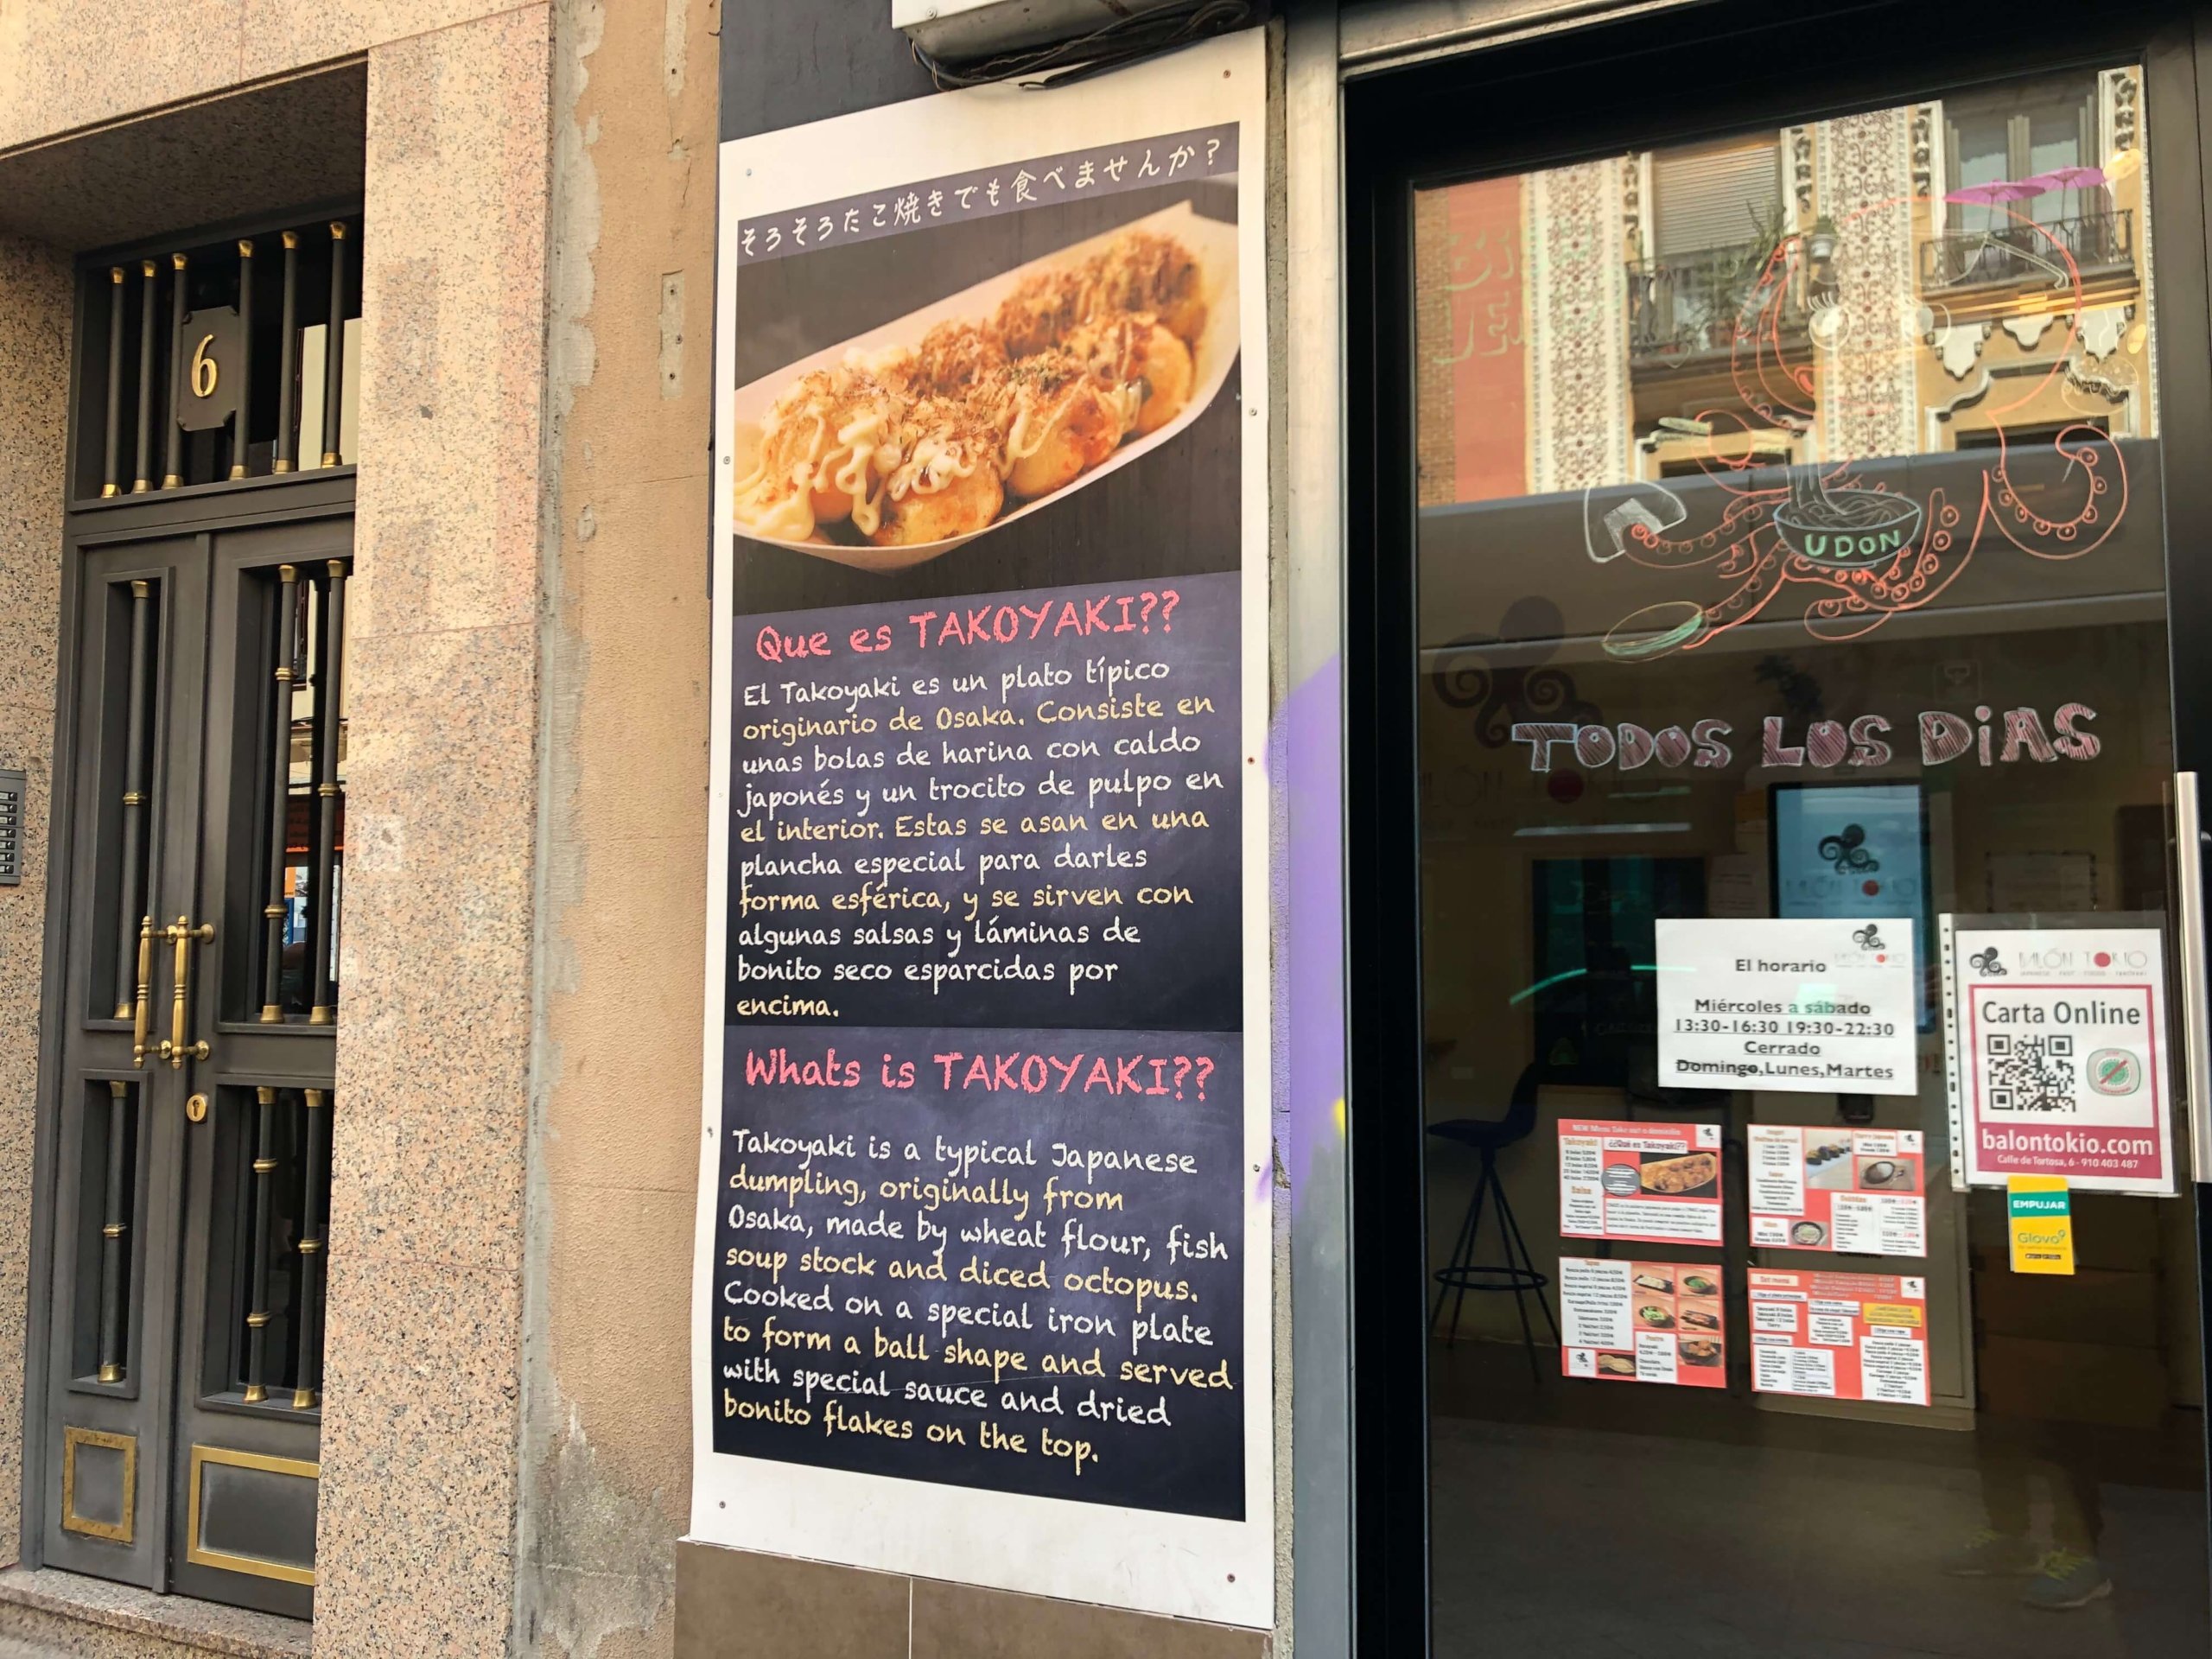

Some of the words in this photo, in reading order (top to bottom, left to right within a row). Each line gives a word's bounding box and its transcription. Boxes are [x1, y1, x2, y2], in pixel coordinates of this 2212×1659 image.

[191, 334, 217, 398] 6
[1804, 529, 1902, 558] UDON
[755, 625, 832, 664] Que
[849, 624, 892, 653] es
[908, 589, 1180, 649] TAKOYAKI??
[743, 682, 771, 707] El
[779, 676, 901, 714] Takoyaki
[912, 677, 940, 696] es
[952, 673, 988, 693] un
[1001, 662, 1073, 704] plato
[1086, 655, 1170, 698] típico
[742, 713, 878, 747] originario
[888, 706, 924, 731] de
[936, 705, 1025, 731] Osaka.
[1036, 692, 1164, 724] Consiste
[1177, 696, 1216, 715] en
[1511, 719, 1733, 772] TODOS
[1762, 714, 1892, 768] LOS
[742, 755, 803, 775] unas
[814, 744, 885, 772] bolas
[896, 741, 931, 766] de
[942, 741, 1033, 765] harina
[1046, 739, 1101, 760] con
[1114, 726, 1201, 756] caldo
[737, 779, 844, 820] japonés
[855, 789, 871, 817] y
[881, 785, 918, 804] un
[929, 773, 1026, 802] trocito
[1038, 769, 1075, 796] de
[1089, 767, 1173, 810] pulpo
[1185, 771, 1224, 791] en
[740, 818, 766, 843] el
[777, 817, 884, 842] interior.
[894, 812, 967, 837] Estas
[979, 817, 1008, 836] se
[1020, 813, 1089, 833] asan
[1101, 811, 1139, 831] en
[1151, 810, 1210, 830] una
[740, 850, 842, 891] plancha
[854, 847, 966, 893] especial
[979, 853, 1041, 886] para
[1053, 842, 1147, 869] darles
[739, 886, 821, 918] forma
[831, 880, 950, 917] esférica,
[963, 892, 978, 922] y
[991, 889, 1020, 907] se
[1032, 884, 1124, 907] sirven
[1136, 885, 1194, 905] con
[738, 922, 842, 955] algunas
[852, 920, 934, 945] salsas
[946, 928, 962, 959] y
[974, 914, 1090, 944] láminas
[1103, 915, 1141, 944] de
[738, 953, 823, 982] bonito
[832, 963, 893, 982] seco
[904, 953, 1055, 995] esparcidas
[1070, 963, 1119, 996] por
[1735, 959, 1751, 972] El
[1758, 959, 1827, 973] horario
[736, 994, 839, 1018] encima.
[1675, 1019, 1778, 1033] 13:30-16:30
[1786, 1020, 1895, 1036] 19:30-22:30
[1694, 999, 1782, 1014] Miércoles
[1788, 1003, 1798, 1014] a
[1804, 1000, 1872, 1014] sábado
[1982, 1001, 2044, 1024] Carta
[2053, 1000, 2140, 1025] Online
[1744, 1040, 1821, 1055] Cerrado
[745, 1047, 861, 1088] Whats
[881, 1053, 916, 1090] is
[933, 1051, 1215, 1103] TAKOYAKI??
[732, 1128, 856, 1171] Takoyaki
[868, 1135, 891, 1160] is
[904, 1142, 921, 1161] a
[935, 1135, 1038, 1179] typical
[1052, 1142, 1198, 1185] Japanese
[1982, 1128, 2153, 1155] balontokio.com
[1997, 1154, 2018, 1165] Calle
[2020, 1155, 2032, 1165] de
[2033, 1156, 2067, 1167] Tortosa,
[2068, 1159, 2075, 1167] 6
[2081, 1158, 2099, 1167] 910
[2101, 1159, 2118, 1168] 403
[2120, 1160, 2139, 1169] 487
[729, 1169, 868, 1209] dumpling,
[879, 1176, 1030, 1223] originally
[1043, 1175, 1124, 1216] from
[2012, 1199, 2066, 1210] EMPUJAR
[728, 1204, 814, 1239] Osaka,
[826, 1209, 905, 1240] made
[917, 1211, 948, 1256] by
[960, 1217, 1047, 1249] wheat
[1060, 1217, 1151, 1262] flour,
[1166, 1224, 1229, 1266] fish
[2018, 1230, 2064, 1244] Glovo
[725, 1247, 788, 1285] soup
[799, 1245, 877, 1276] stock
[888, 1251, 947, 1283] and
[959, 1255, 1051, 1289] diced
[1064, 1266, 1198, 1314] octopus.
[723, 1280, 835, 1313] Cooked
[844, 1295, 884, 1317] on
[895, 1300, 913, 1320] a
[926, 1301, 1033, 1339] special
[1048, 1306, 1116, 1337] iron
[1132, 1312, 1214, 1357] plate
[723, 1315, 751, 1343] to
[761, 1315, 831, 1354] form
[843, 1335, 861, 1356] a
[874, 1325, 931, 1361] ball
[944, 1337, 1028, 1385] shape
[1041, 1347, 1106, 1378] and
[1119, 1358, 1234, 1390] served
[722, 1356, 781, 1385] with
[791, 1369, 891, 1404] special
[904, 1380, 990, 1408] sauce
[1001, 1384, 1065, 1415] and
[1077, 1389, 1172, 1427] dried
[723, 1387, 812, 1426] bonito
[823, 1399, 913, 1440] flakes
[925, 1423, 967, 1446] on
[979, 1420, 1028, 1454] the
[1041, 1427, 1099, 1477] top.
